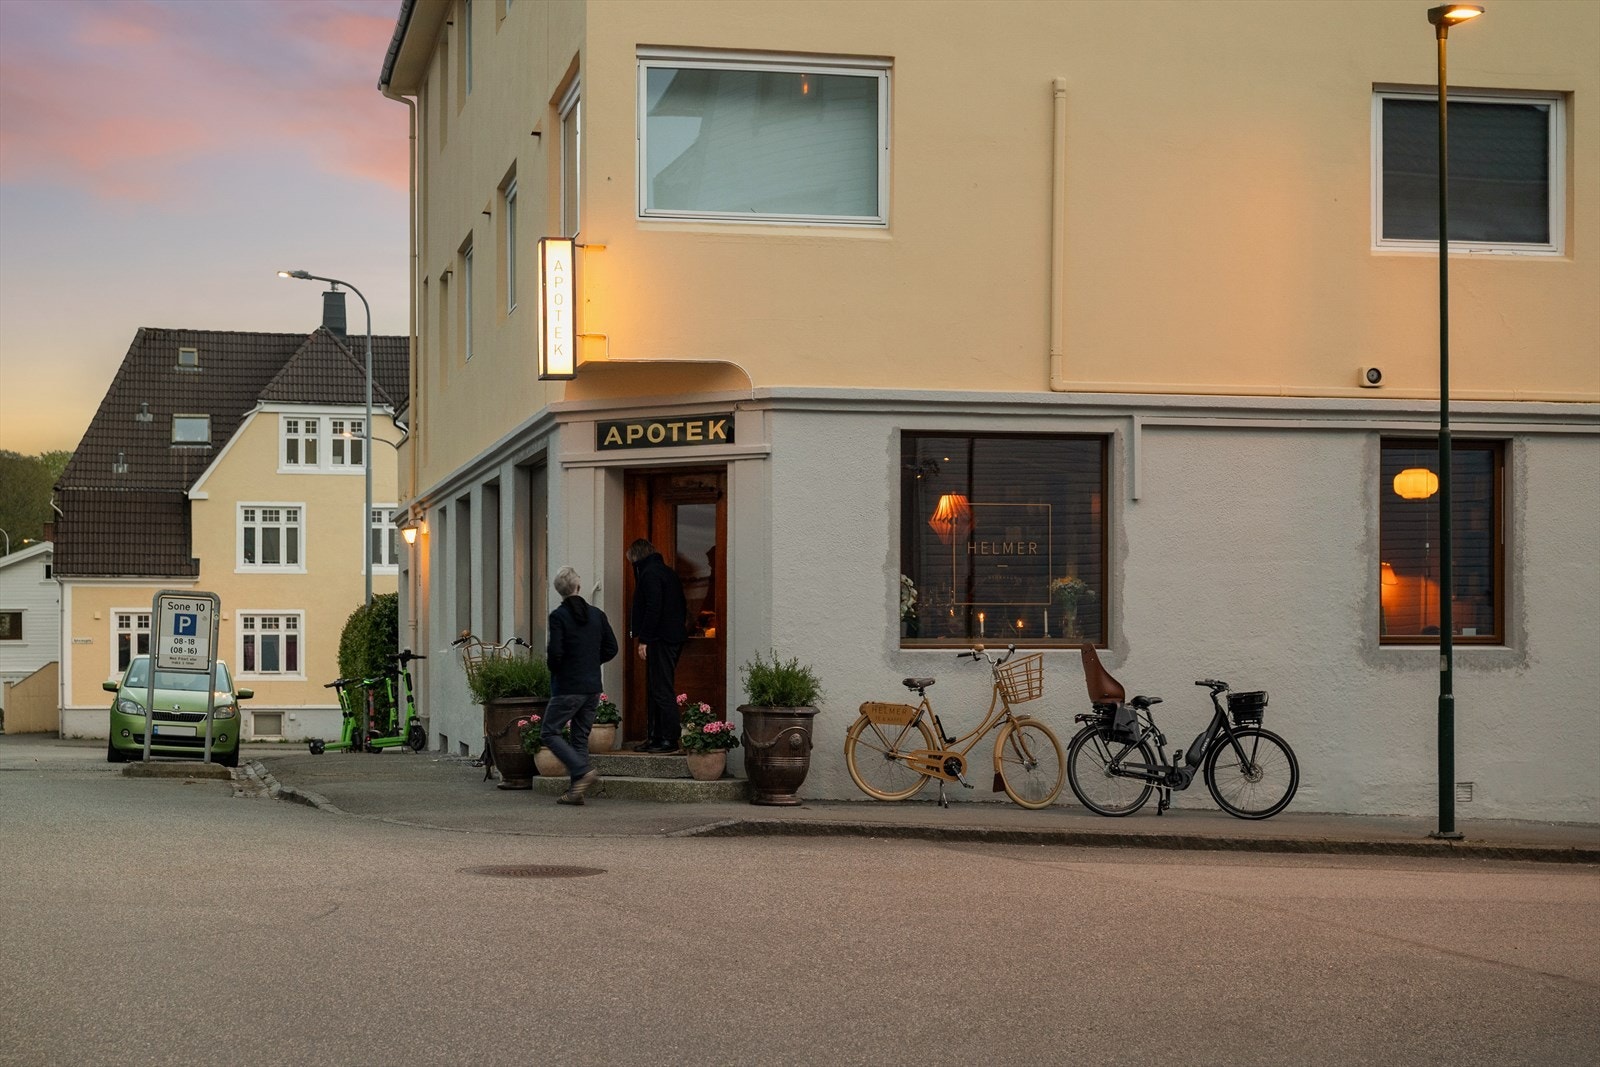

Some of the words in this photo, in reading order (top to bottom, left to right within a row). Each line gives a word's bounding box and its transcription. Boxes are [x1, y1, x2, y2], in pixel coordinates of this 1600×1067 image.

[553, 260, 563, 356] APOTEK
[603, 419, 727, 446] APOTEK
[967, 541, 1038, 555] HELMER
[167, 601, 191, 611] Sone
[196, 603, 205, 612] 10
[179, 616, 192, 633] P
